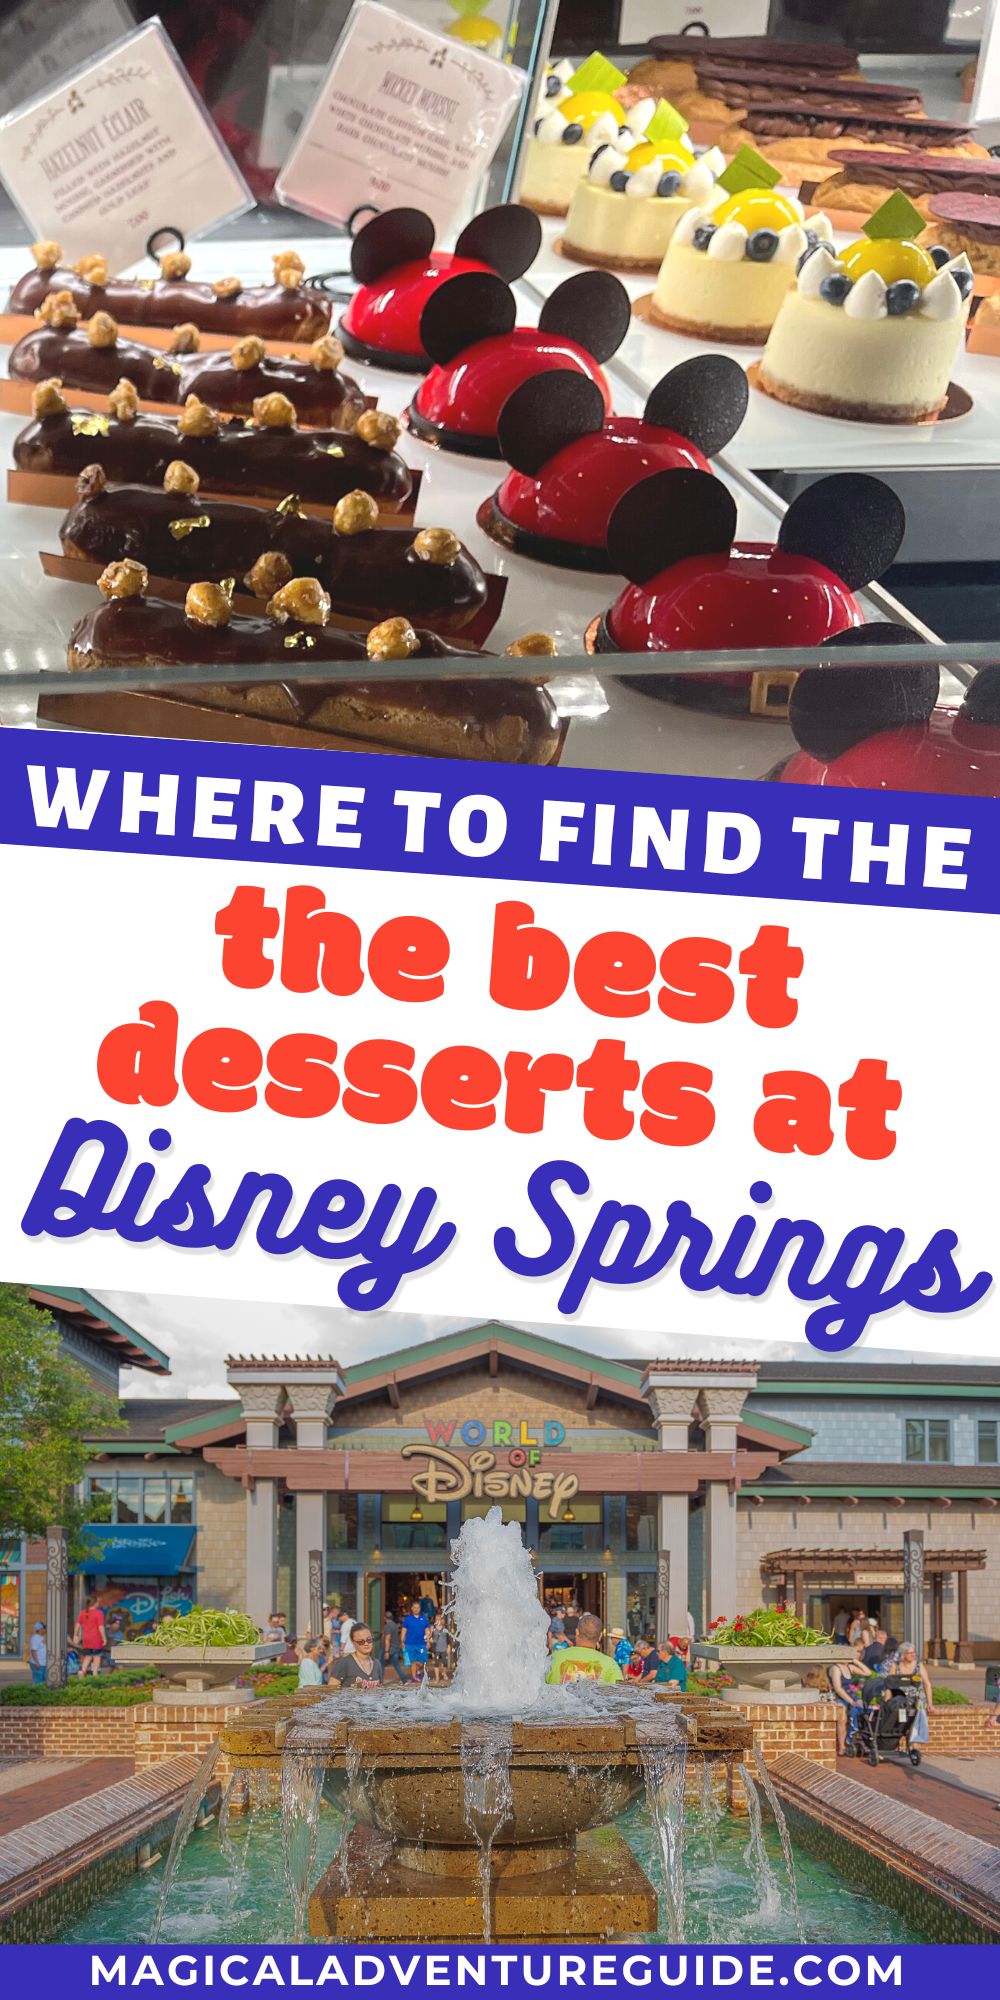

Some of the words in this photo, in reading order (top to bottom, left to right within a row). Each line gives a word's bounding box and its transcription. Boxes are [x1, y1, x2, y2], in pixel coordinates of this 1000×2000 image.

[379, 72, 420, 103] MICKEY
[39, 127, 104, 180] HAZELNUT
[100, 97, 150, 140] ÉCLAIR
[424, 1420, 565, 1447] WORLD
[508, 1448, 541, 1467] OF
